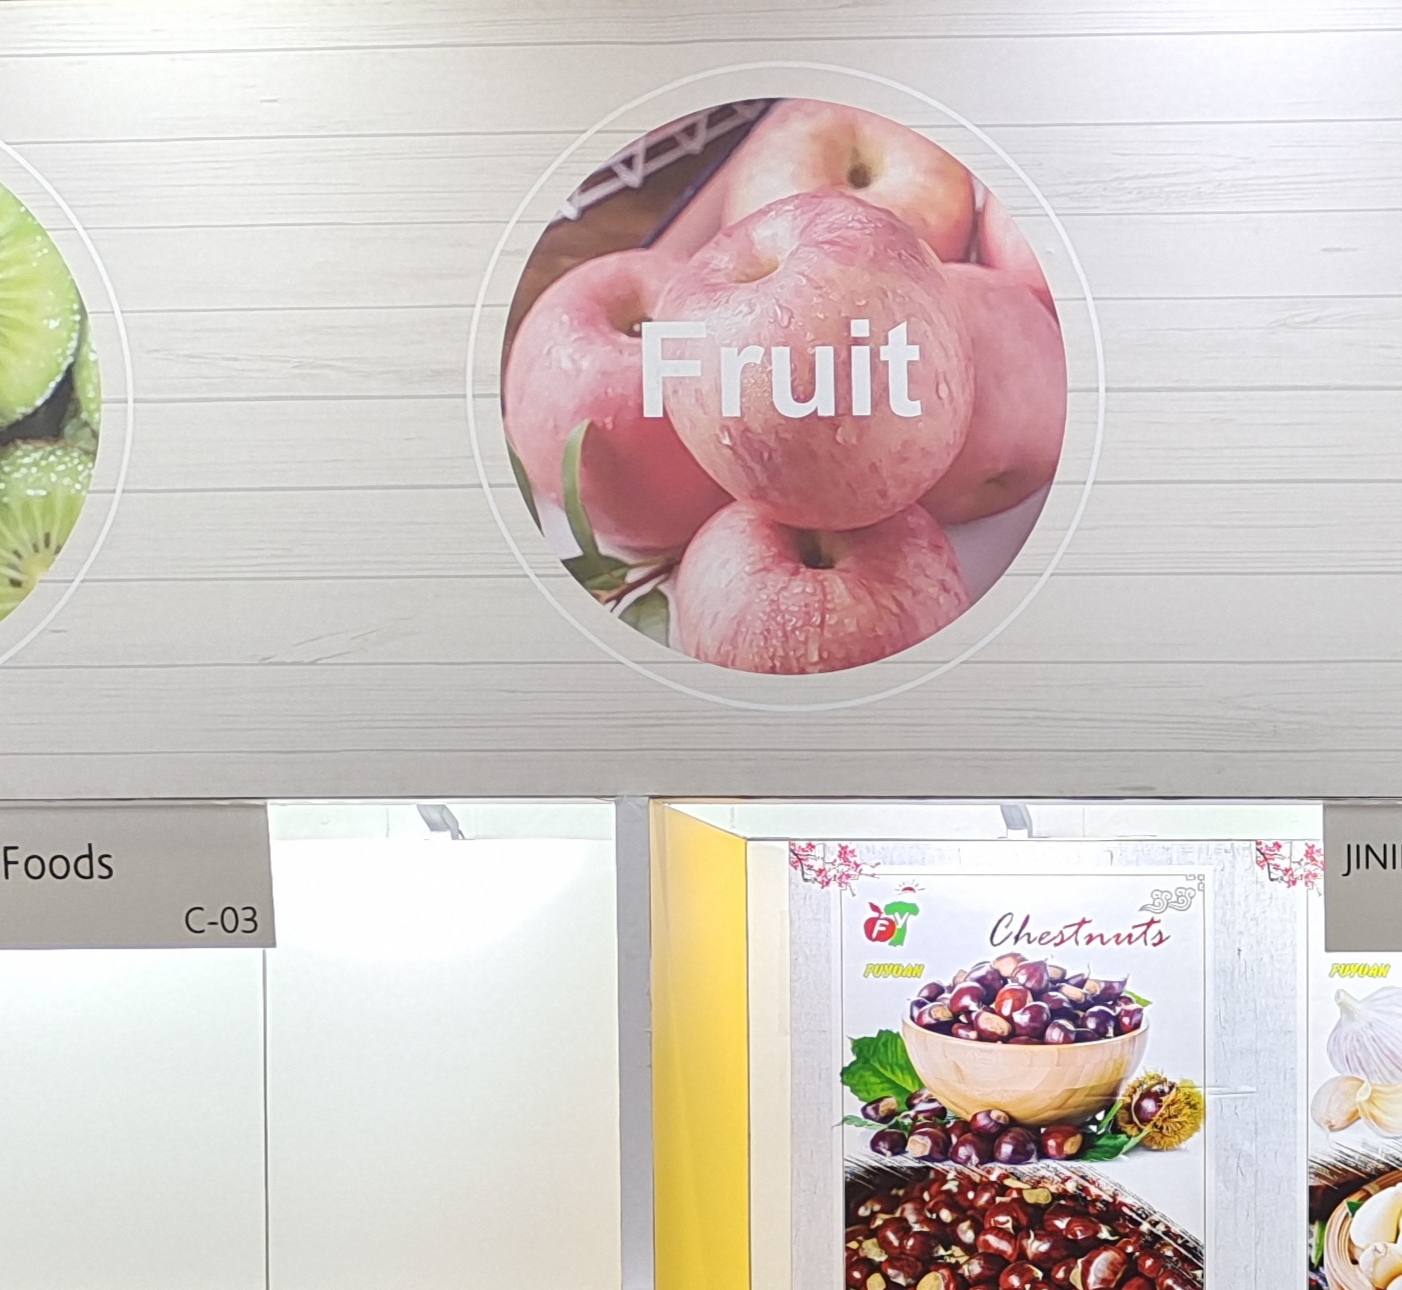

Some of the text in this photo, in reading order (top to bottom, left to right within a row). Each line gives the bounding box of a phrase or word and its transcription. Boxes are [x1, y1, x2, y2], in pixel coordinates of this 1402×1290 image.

[641, 318, 922, 418] Fruit
[3, 843, 114, 880] Foods
[185, 907, 258, 934] C-03
[989, 911, 1172, 948] Chestnuts
[863, 963, 925, 978] FUYUAN
[1328, 963, 1390, 978] FUYUAN
